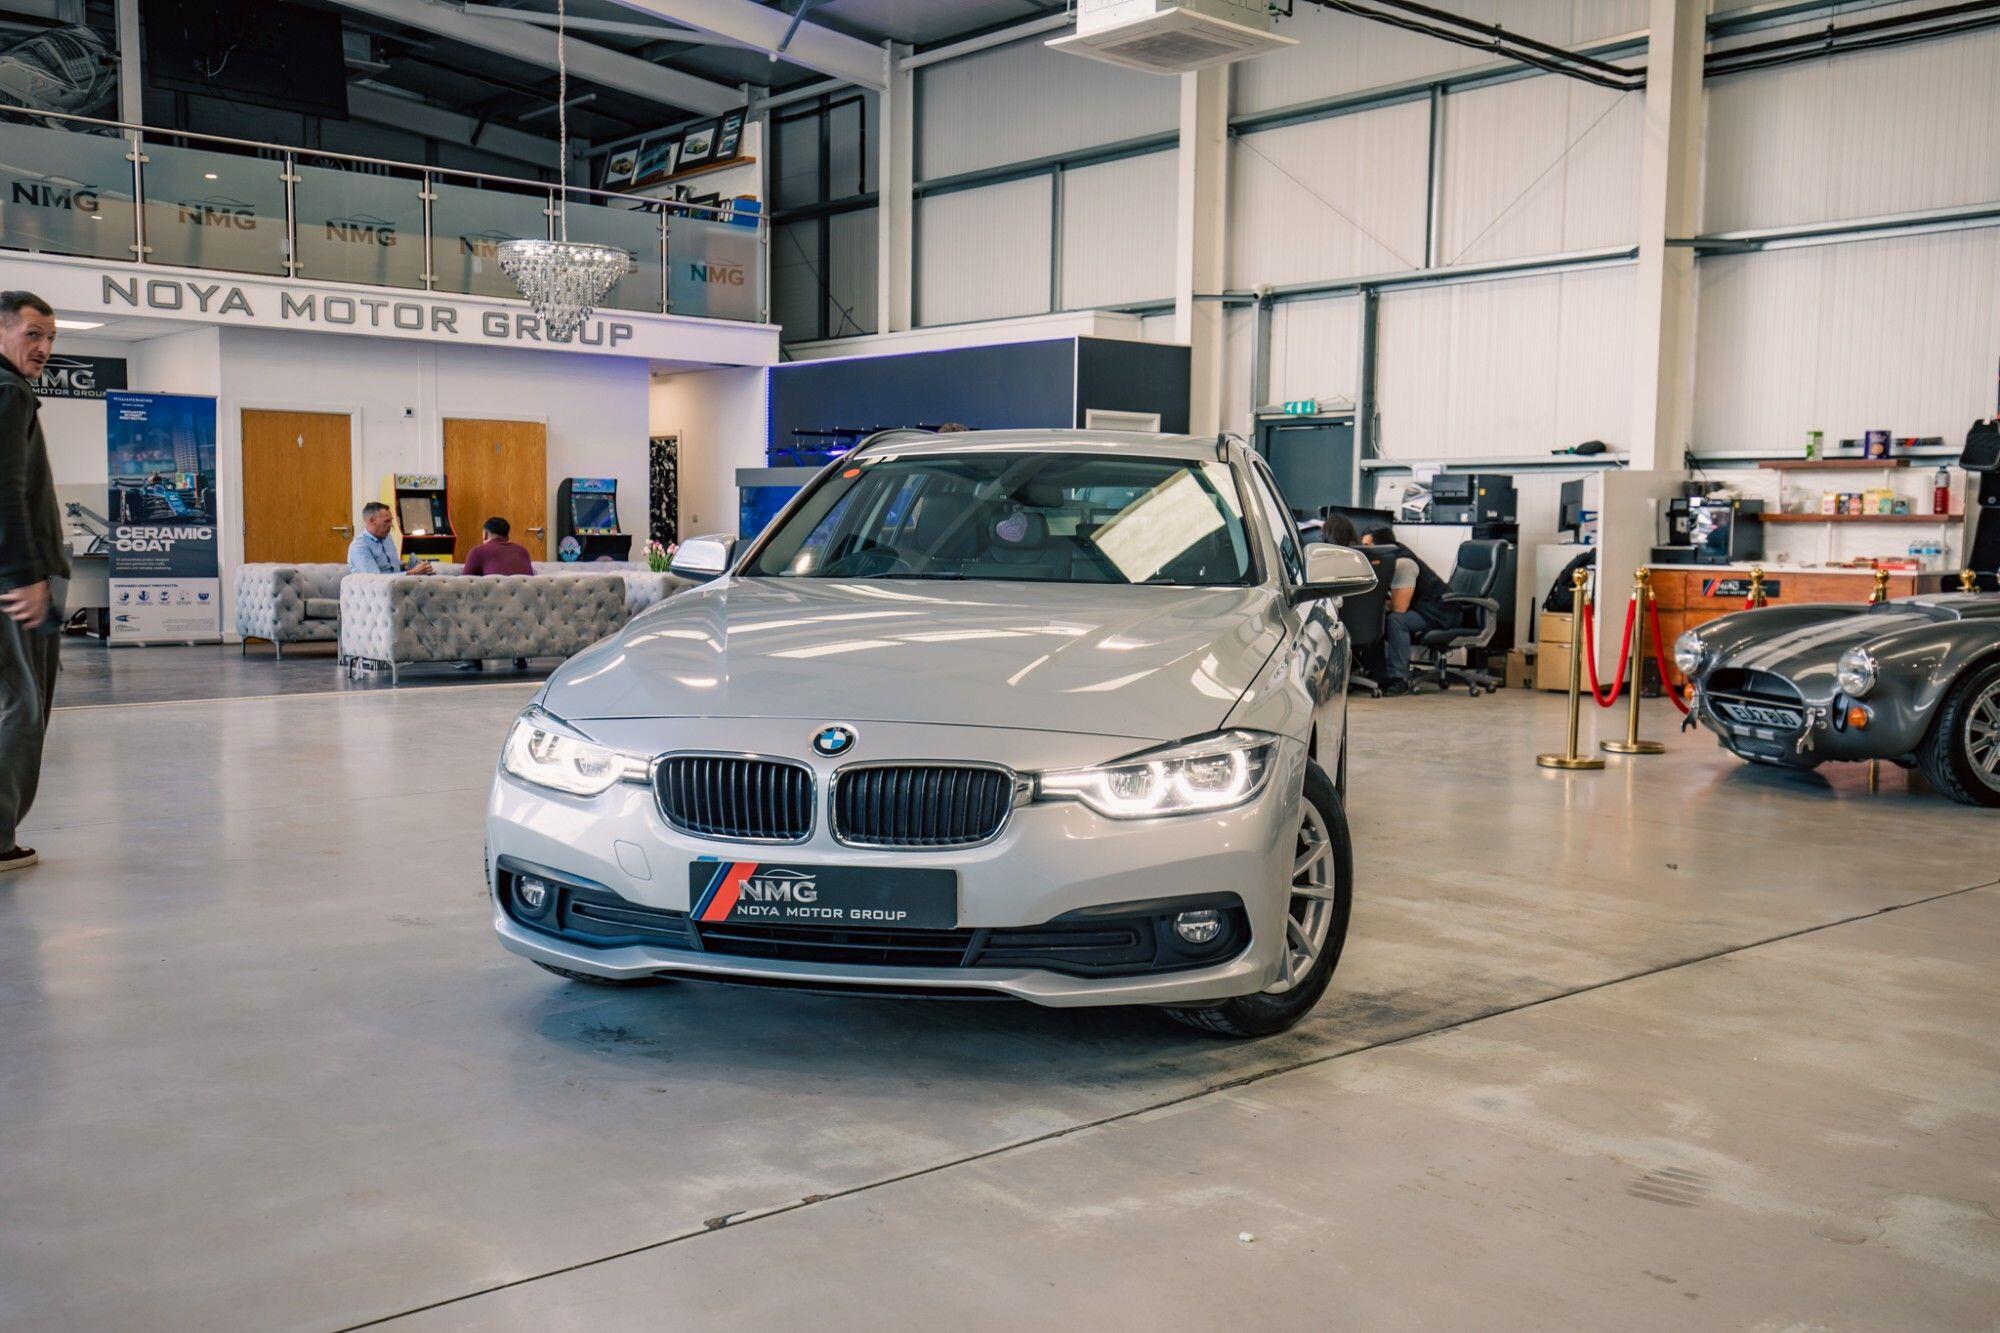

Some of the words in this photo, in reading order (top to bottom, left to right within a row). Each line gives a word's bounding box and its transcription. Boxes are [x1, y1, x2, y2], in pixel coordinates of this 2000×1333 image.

[12, 182, 100, 212] NMG
[178, 202, 256, 230] NMG
[326, 221, 397, 247] NMG
[459, 236, 498, 257] NM
[690, 264, 744, 286] NMG
[102, 275, 254, 316] NOYA
[281, 292, 458, 334] MOTOR
[32, 387, 69, 395] MOTOR
[115, 526, 212, 540] CERAMIC
[115, 539, 175, 552] COAT
[738, 879, 818, 903] NMG
[737, 906, 779, 917] NOYA
[786, 907, 843, 919] MOTOR
[850, 909, 907, 920] GROUP
